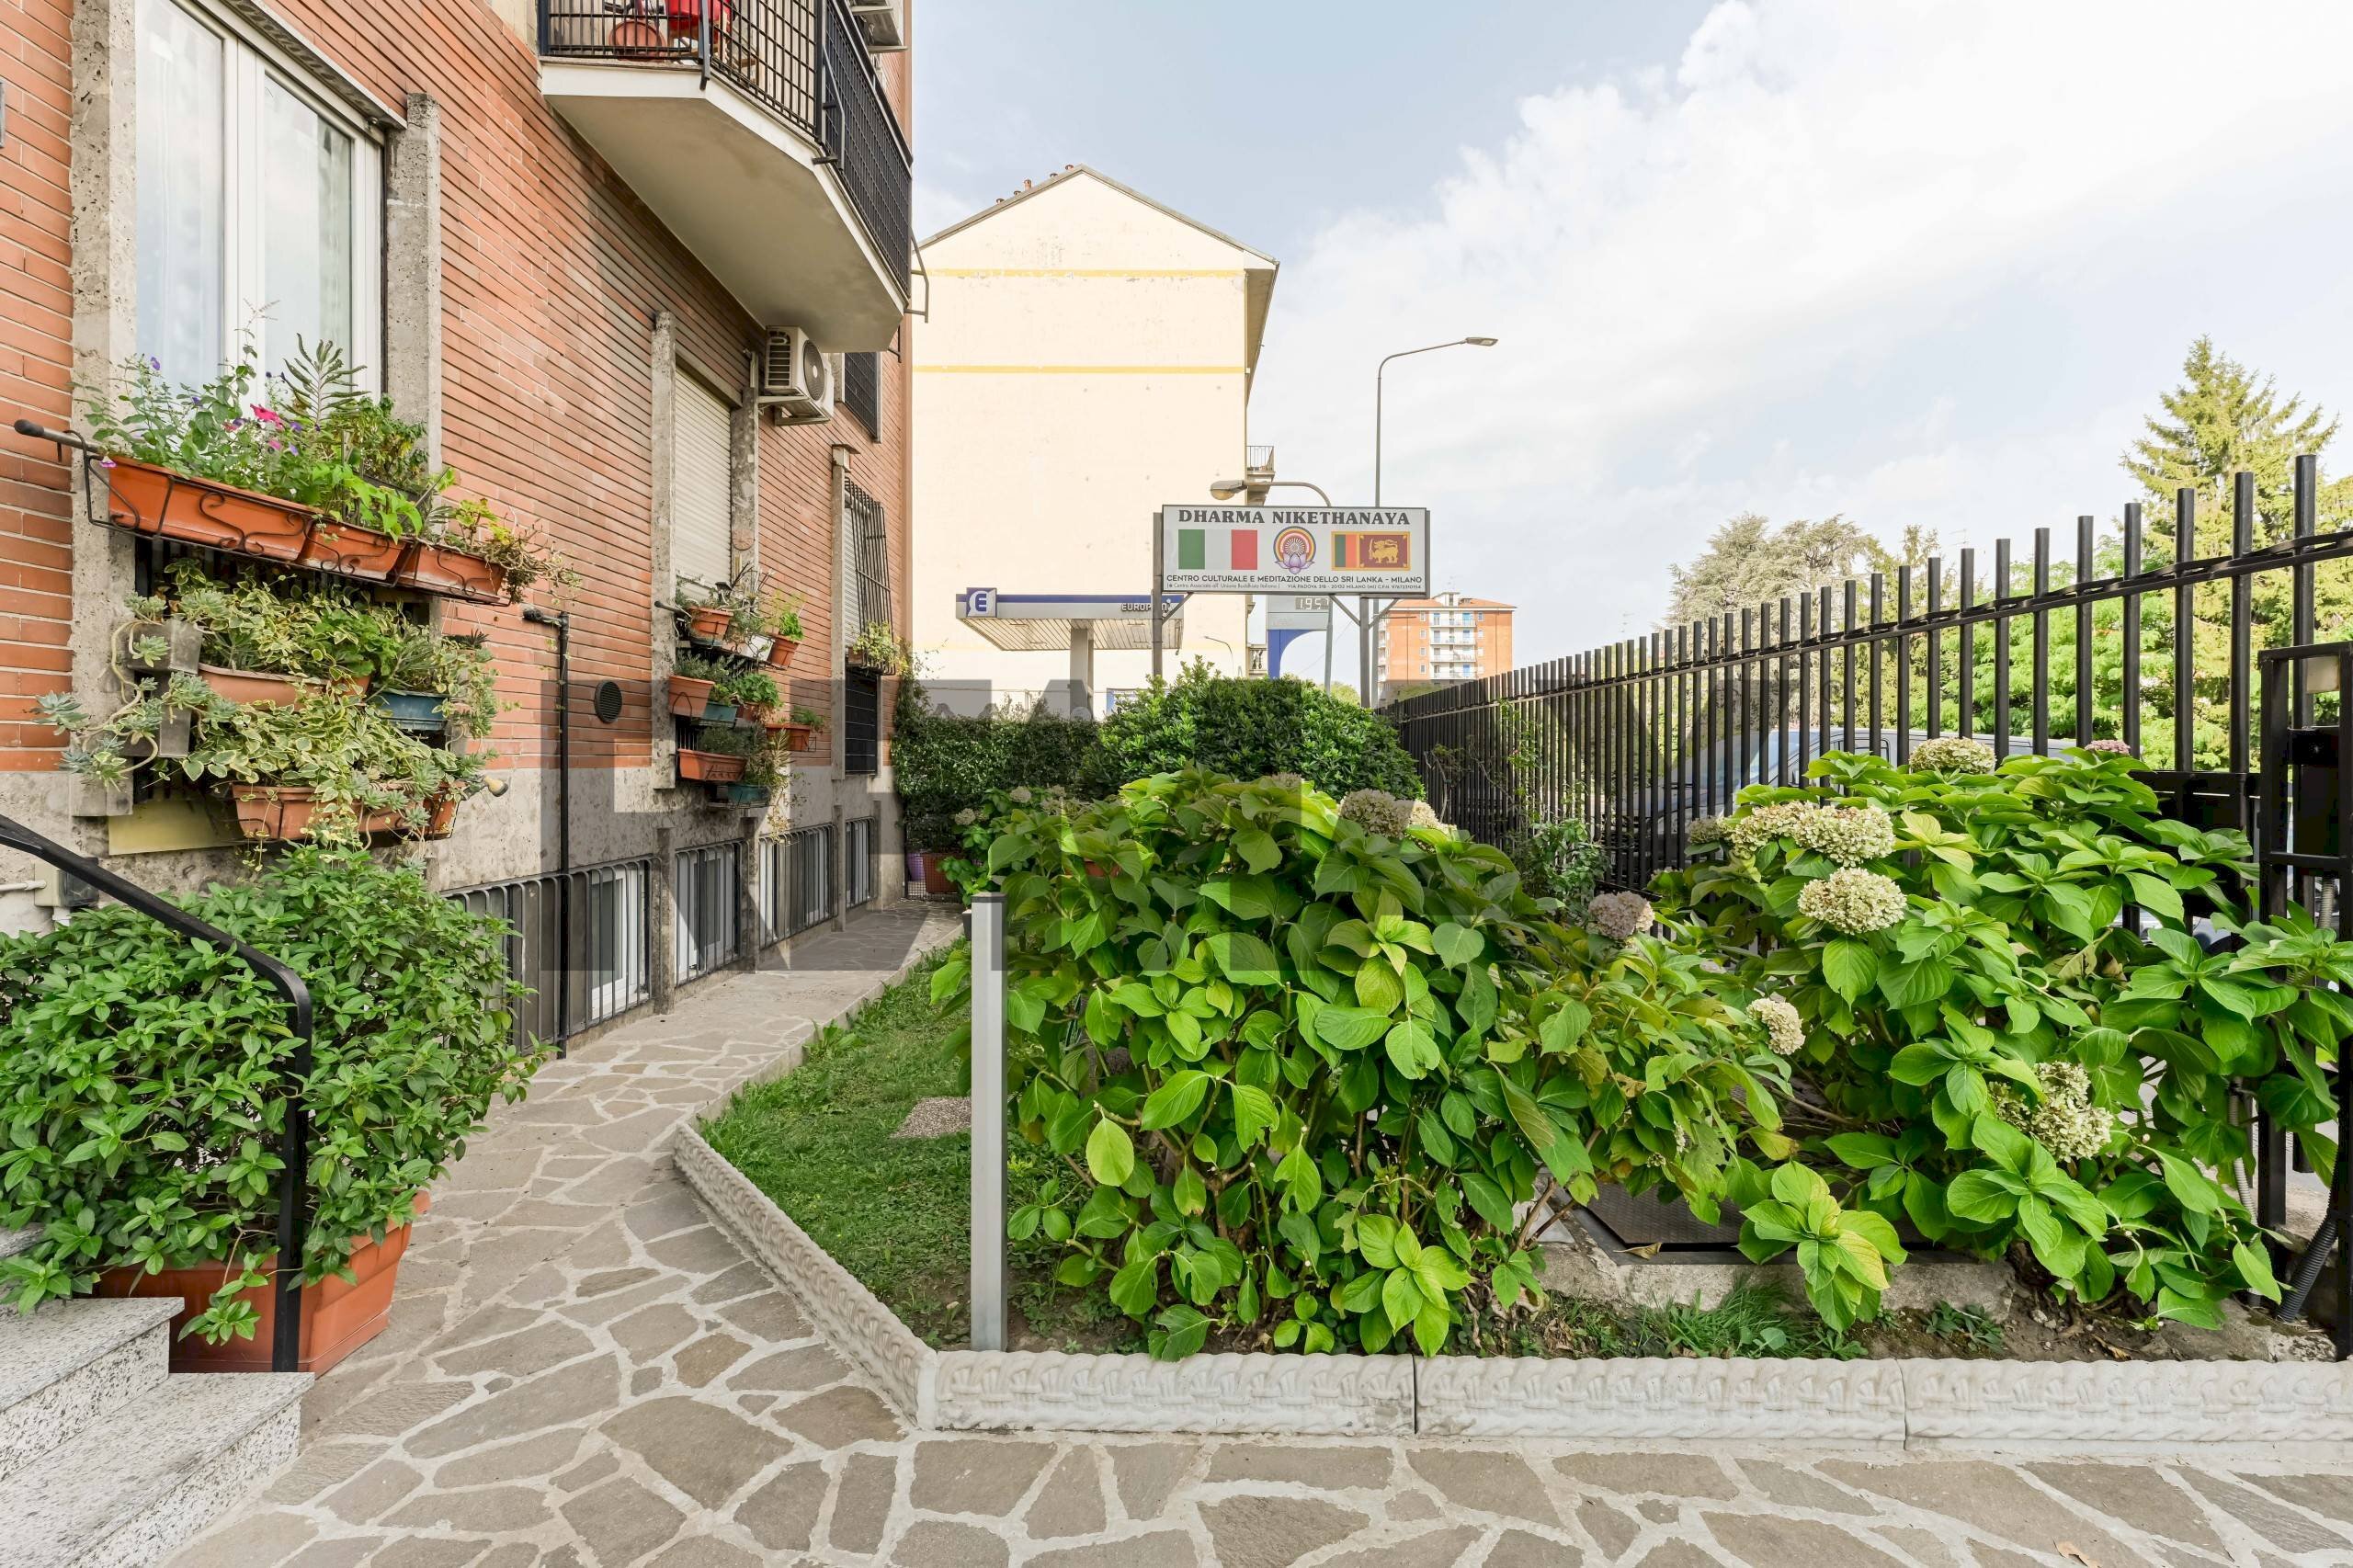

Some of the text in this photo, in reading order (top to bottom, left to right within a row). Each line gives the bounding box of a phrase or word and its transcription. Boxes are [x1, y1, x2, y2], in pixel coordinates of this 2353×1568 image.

[1178, 509, 1410, 525] DHARMA NIKETHANAYA
[1166, 574, 1199, 583] CENTRO
[1201, 574, 1248, 584] CULTURALE
[1249, 575, 1256, 584] E
[1256, 575, 1312, 584] MEDITAZIONE
[1313, 575, 1339, 584] DELLO
[1390, 576, 1422, 585] MILANO
